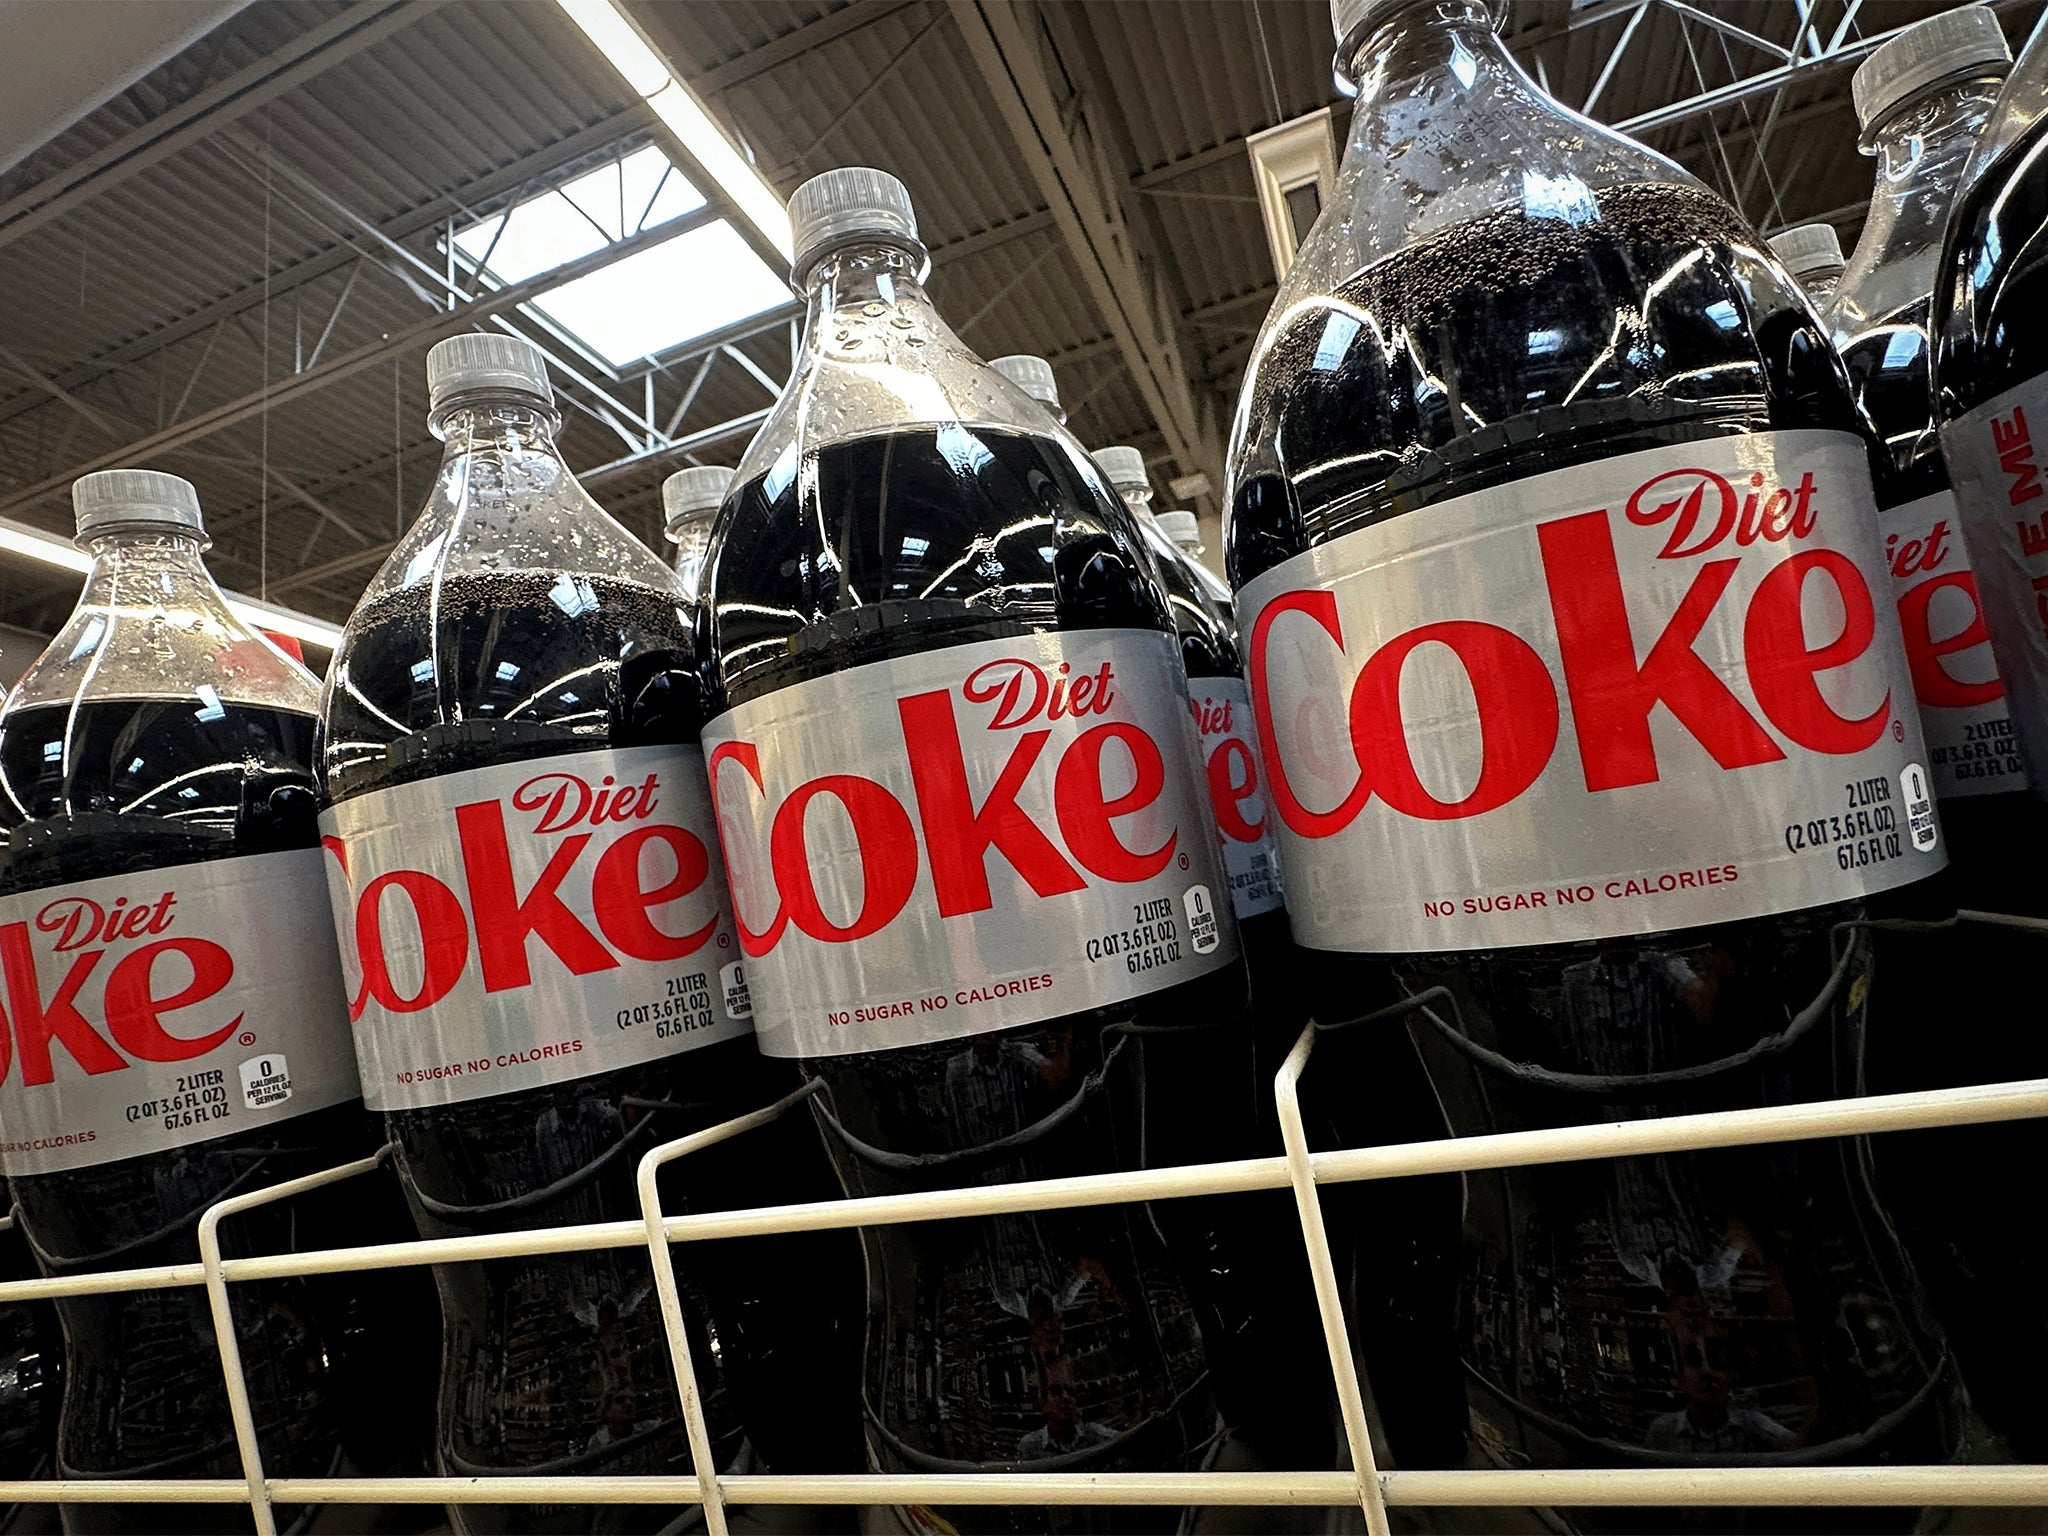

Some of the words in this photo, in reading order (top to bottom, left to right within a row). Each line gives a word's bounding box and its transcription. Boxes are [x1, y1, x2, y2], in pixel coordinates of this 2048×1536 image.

[1990, 405, 2044, 506] ME
[1624, 468, 1817, 559] Diet
[1886, 520, 1952, 577] iet
[1250, 509, 1891, 839] Coke
[962, 657, 1115, 730] Diet
[1191, 697, 1233, 735] iet
[512, 772, 660, 834] Diet
[1846, 784, 1857, 808] 2
[1857, 776, 1891, 805] LITER
[1912, 773, 1921, 799] 0
[709, 688, 1178, 958] Coke
[1785, 825, 1806, 853] (2
[1808, 819, 1829, 846] QT
[1830, 814, 1855, 840] 3.6
[1858, 810, 1874, 835] FL
[1875, 805, 1896, 832] OZ)
[1838, 844, 1868, 871] 67.6
[1870, 840, 1886, 864] FL
[1886, 833, 1903, 859] OZ
[1194, 892, 1203, 914] 0
[1423, 901, 1455, 918] NO
[1463, 891, 1548, 915] SUGAR
[1556, 885, 1595, 905] NO
[1604, 864, 1739, 899] CALORIES
[36, 891, 178, 951] Diet
[1133, 905, 1143, 924] 2
[1143, 898, 1173, 922] LITER
[1086, 938, 1101, 963] (2
[1103, 934, 1121, 957] QT
[1123, 928, 1142, 951] 3.6
[1144, 926, 1157, 946] FL
[1158, 920, 1177, 941] OZ)
[1126, 951, 1153, 974] 67.6
[1154, 947, 1167, 967] FL
[1168, 941, 1182, 962] OZ
[666, 980, 674, 997] 2
[677, 972, 708, 994] LITER
[733, 966, 744, 985] 0
[0, 921, 244, 1087] ke
[617, 1009, 632, 1030] (2
[633, 1005, 650, 1024] QT
[651, 1000, 673, 1019] 3.6
[674, 998, 688, 1013] FL
[690, 992, 711, 1009] OZ)
[828, 1011, 850, 1027] NO
[855, 1001, 915, 1023] SUGAR
[920, 995, 948, 1013] NO
[955, 974, 1053, 1005] CALORIES
[656, 1018, 682, 1039] 67.6
[684, 1015, 697, 1032] FL
[699, 1009, 714, 1027] OZ
[176, 1078, 185, 1092] 2
[188, 1069, 224, 1091] LITER
[260, 1060, 272, 1077] 0
[396, 1072, 413, 1084] NO
[416, 1063, 463, 1082] SUGAR
[467, 1058, 491, 1074] NO
[496, 1039, 583, 1068] CALORIES
[126, 1105, 140, 1122] (2
[142, 1101, 158, 1117] QT
[162, 1096, 182, 1114] 3.6
[186, 1093, 201, 1109] FL
[202, 1086, 226, 1103] OZ)
[247, 1089, 262, 1099] PER
[263, 1086, 271, 1095] 12
[272, 1084, 281, 1093] FL
[165, 1112, 192, 1130] 67.6
[195, 1108, 210, 1123] FL
[212, 1102, 230, 1119] OZ
[33, 1130, 97, 1150] CALORIES
